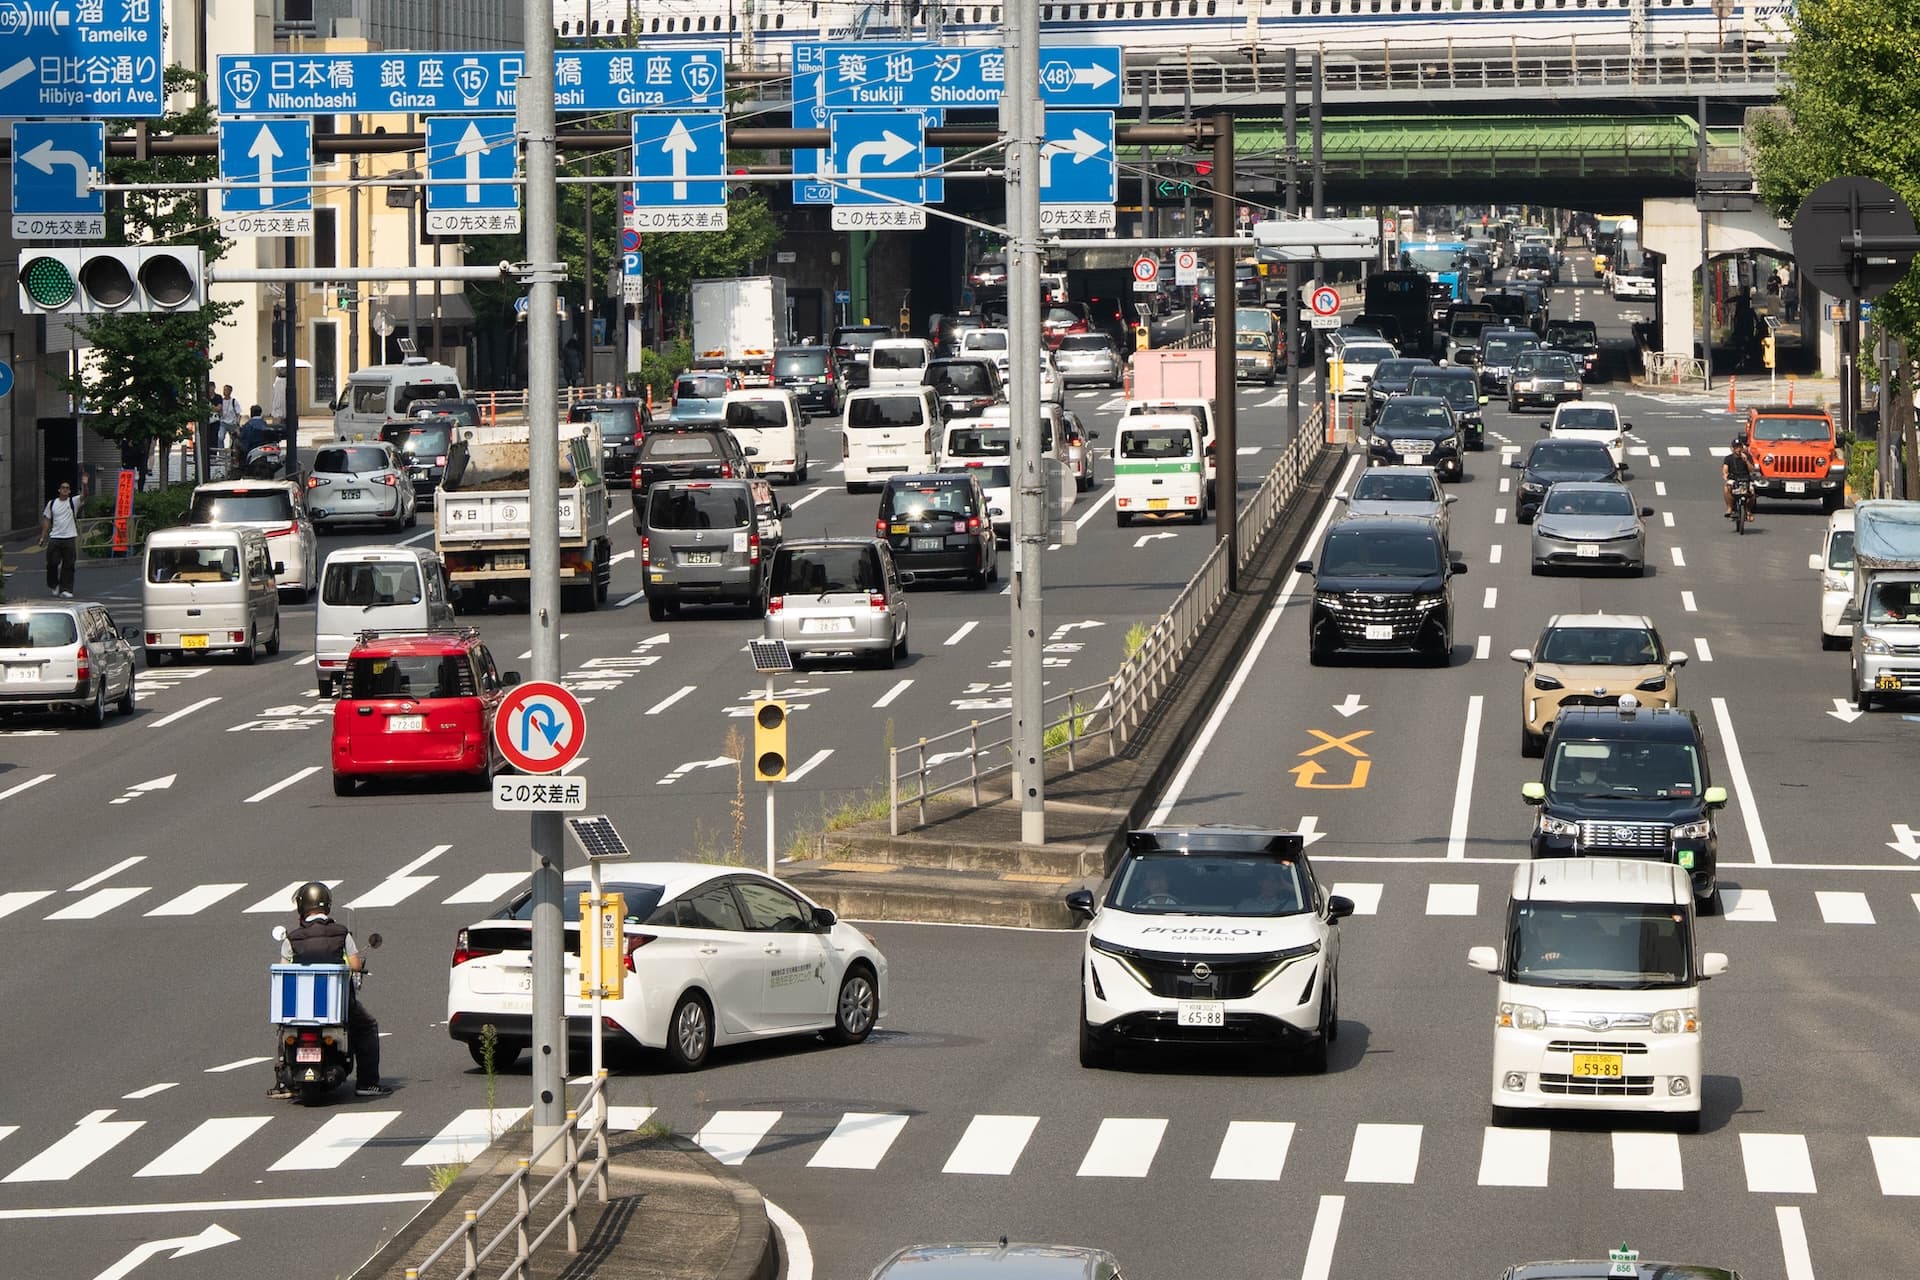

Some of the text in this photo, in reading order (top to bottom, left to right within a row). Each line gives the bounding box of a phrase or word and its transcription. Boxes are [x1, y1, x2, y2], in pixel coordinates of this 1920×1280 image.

[78, 26, 147, 42] Tameike
[40, 55, 156, 84] 日比谷通り
[271, 58, 445, 90] 日本橋 銀座
[608, 56, 673, 86] 銀座
[688, 67, 709, 87] 15
[1046, 69, 1070, 84] 481
[232, 74, 253, 93] 15
[461, 71, 482, 90] 15
[39, 88, 157, 106] Hibiya-dori Ave.
[268, 91, 436, 109] Nihonbashi Ginza
[617, 88, 664, 104] Ginza
[851, 86, 904, 105] Tsukiji
[814, 109, 826, 119] 15
[224, 216, 311, 233] この先交差点
[432, 215, 517, 231] この先交差点
[638, 212, 724, 229] この先交差点
[836, 211, 922, 226] この先交差点
[1040, 209, 1112, 224] の先交差点
[17, 220, 102, 235] この先交差点
[623, 254, 639, 274] P
[500, 783, 580, 804] この交差点
[1188, 1012, 1221, 1024] 65-88
[1584, 1063, 1618, 1076] 59-89
